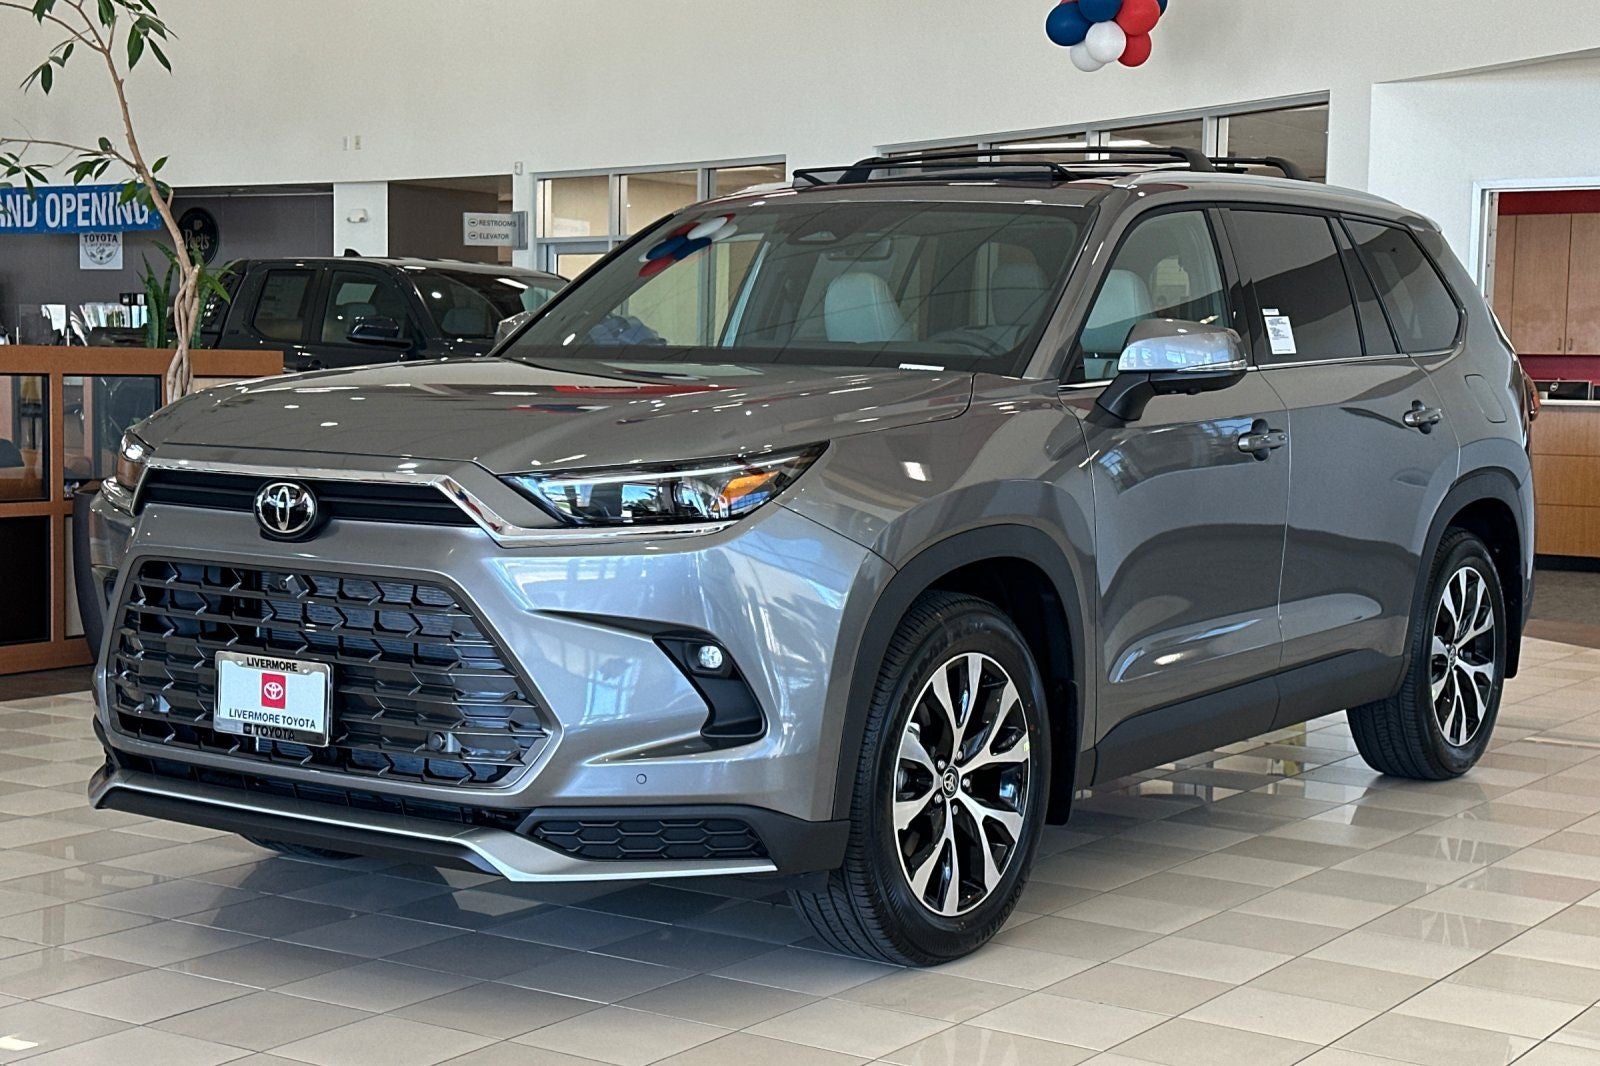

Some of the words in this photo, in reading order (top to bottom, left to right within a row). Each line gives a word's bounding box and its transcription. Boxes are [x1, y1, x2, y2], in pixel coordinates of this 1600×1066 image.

[45, 191, 149, 228] OPENING
[479, 219, 517, 227] RESTROOMS
[84, 233, 118, 243] TOYOTA
[246, 656, 298, 672] LIVERMORE
[229, 708, 280, 724] LIVERMORE
[281, 715, 316, 729] TOYOTA
[254, 725, 295, 740] TOYOTA
